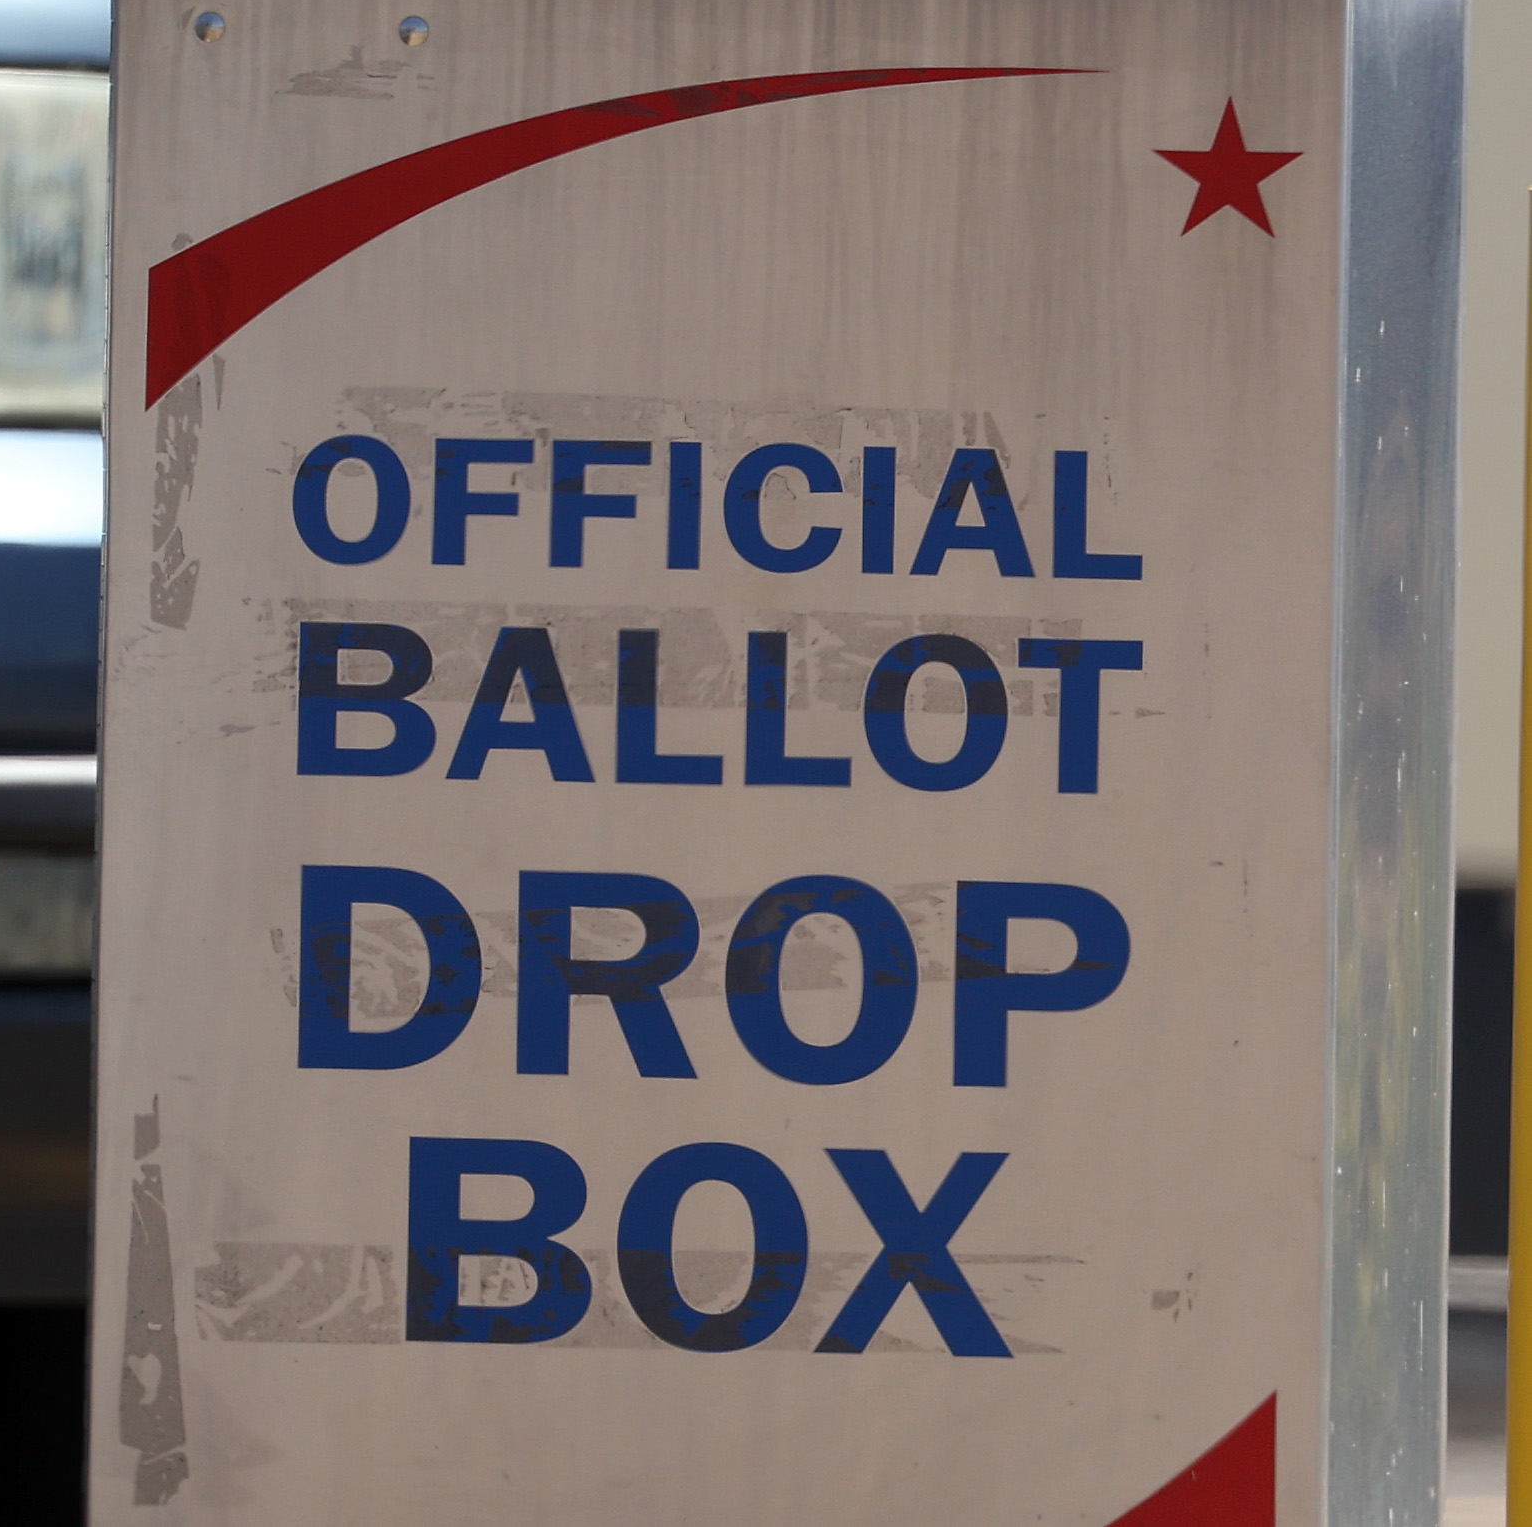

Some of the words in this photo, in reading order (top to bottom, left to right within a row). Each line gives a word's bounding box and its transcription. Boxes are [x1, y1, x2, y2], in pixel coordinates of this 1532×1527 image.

[291, 434, 1144, 581] OFFICIAL
[296, 621, 1144, 794] BALLOT
[297, 864, 1132, 1088] DROP
[406, 1135, 1014, 1359] BOX
